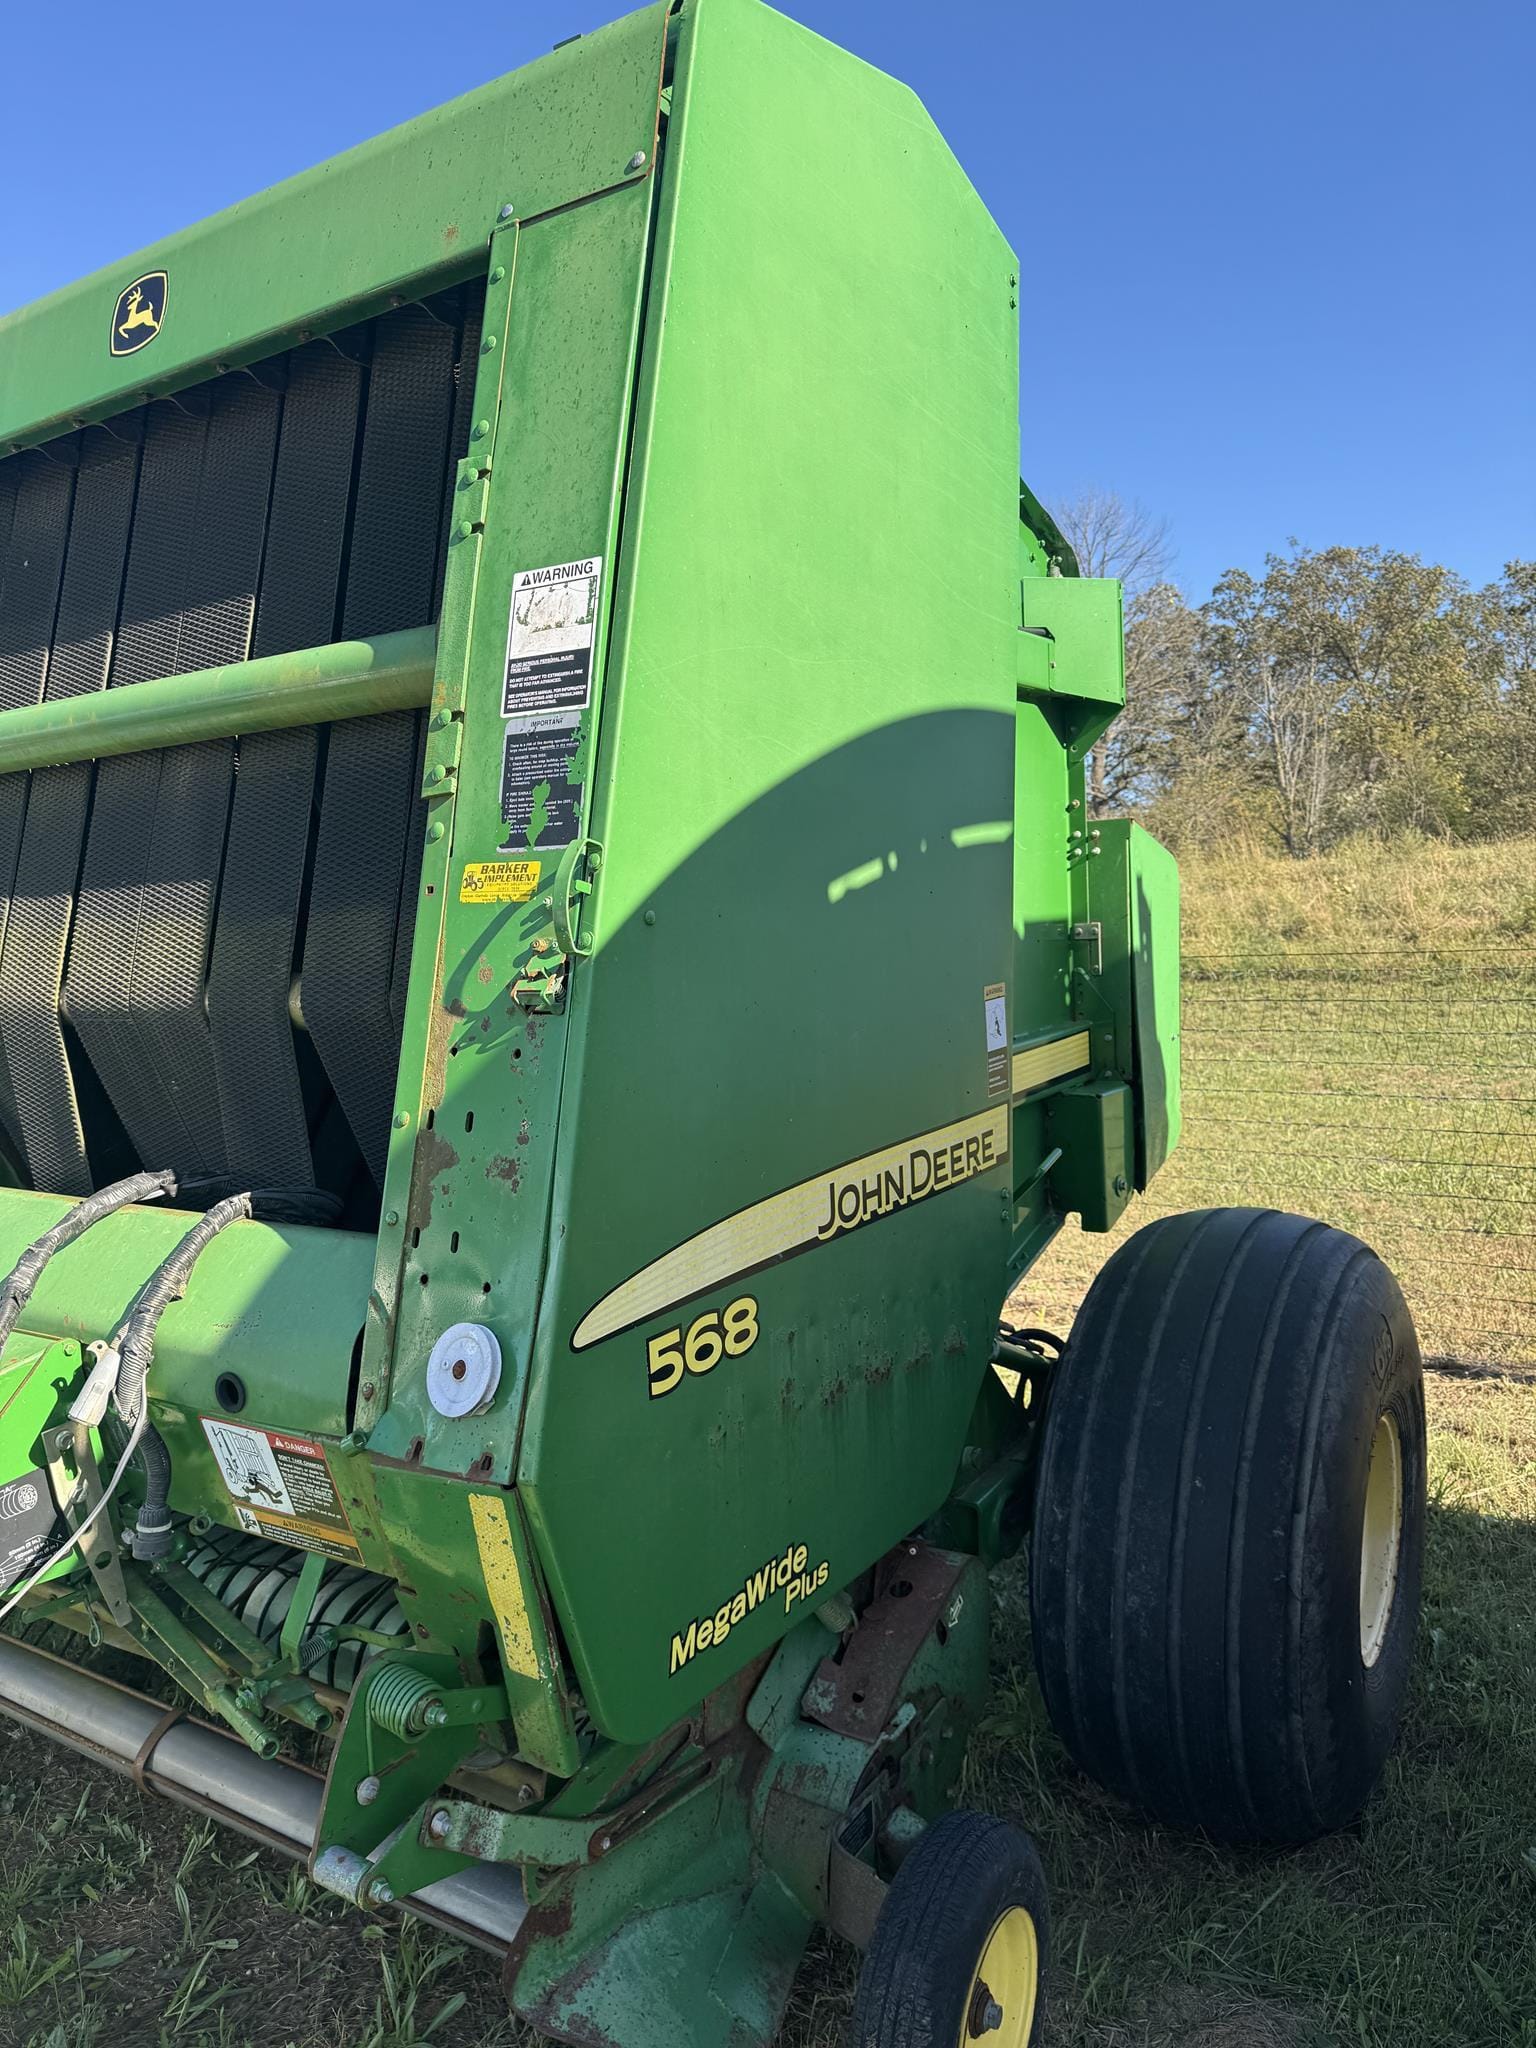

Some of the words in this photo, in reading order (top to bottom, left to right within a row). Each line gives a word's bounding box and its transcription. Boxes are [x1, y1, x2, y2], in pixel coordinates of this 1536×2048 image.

[533, 562, 593, 583] WARNING
[531, 718, 563, 727] IMPORTANT
[480, 864, 529, 874] BARKER
[484, 873, 537, 882] IMPLEMENT
[817, 1164, 905, 1236] JOHN
[909, 1129, 996, 1197] DEERE
[647, 1296, 759, 1398] 568
[284, 1442, 316, 1455] DANGER
[784, 1562, 829, 1613] Plus
[670, 1544, 808, 1674] MegaWide
